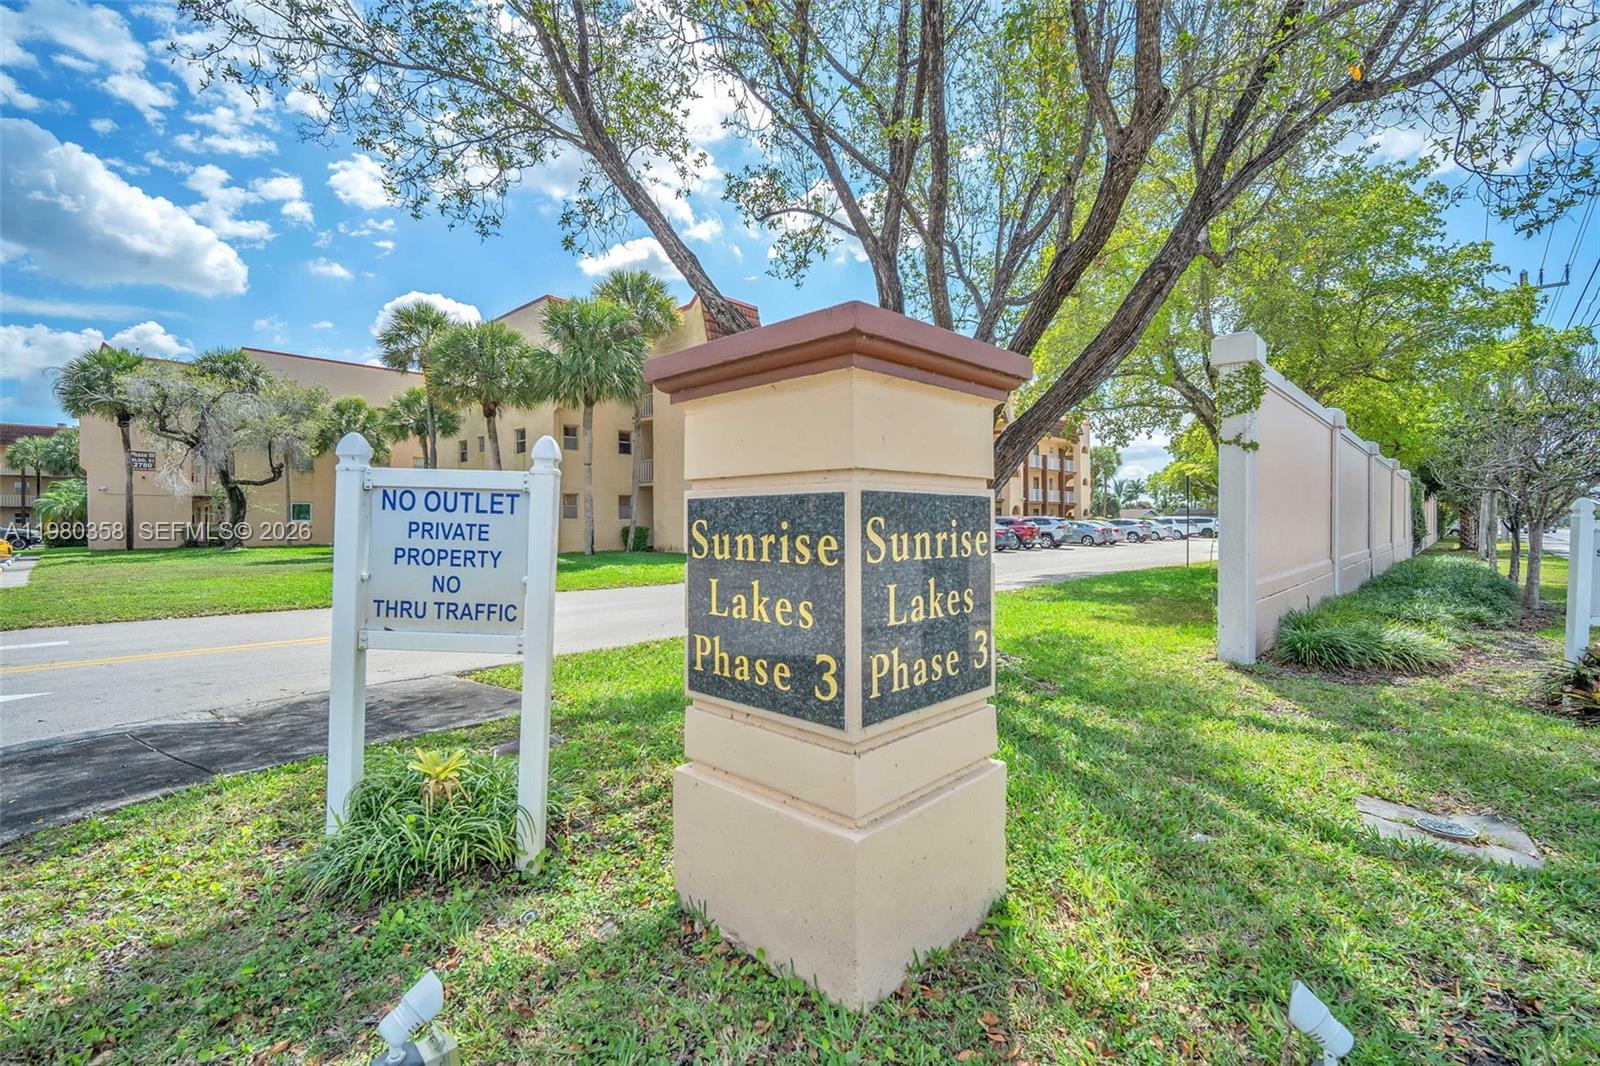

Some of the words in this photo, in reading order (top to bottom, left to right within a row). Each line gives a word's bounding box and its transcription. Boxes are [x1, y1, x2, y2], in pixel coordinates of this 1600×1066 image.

[381, 489, 416, 512] NO
[424, 490, 520, 515] OUTLET
[408, 521, 490, 542] PRIVATE
[691, 518, 839, 567] Sunrise
[865, 516, 988, 564] Sunrise
[394, 547, 502, 569] PROPERTY
[432, 575, 461, 594] NO
[708, 578, 815, 630] Lakes
[887, 576, 974, 627] Lakes
[373, 599, 427, 619] THRU
[433, 601, 518, 623] TRAFFIC
[694, 633, 792, 692] Phase
[814, 653, 839, 701] 3
[869, 647, 960, 699] Phase
[973, 629, 988, 669] 3
